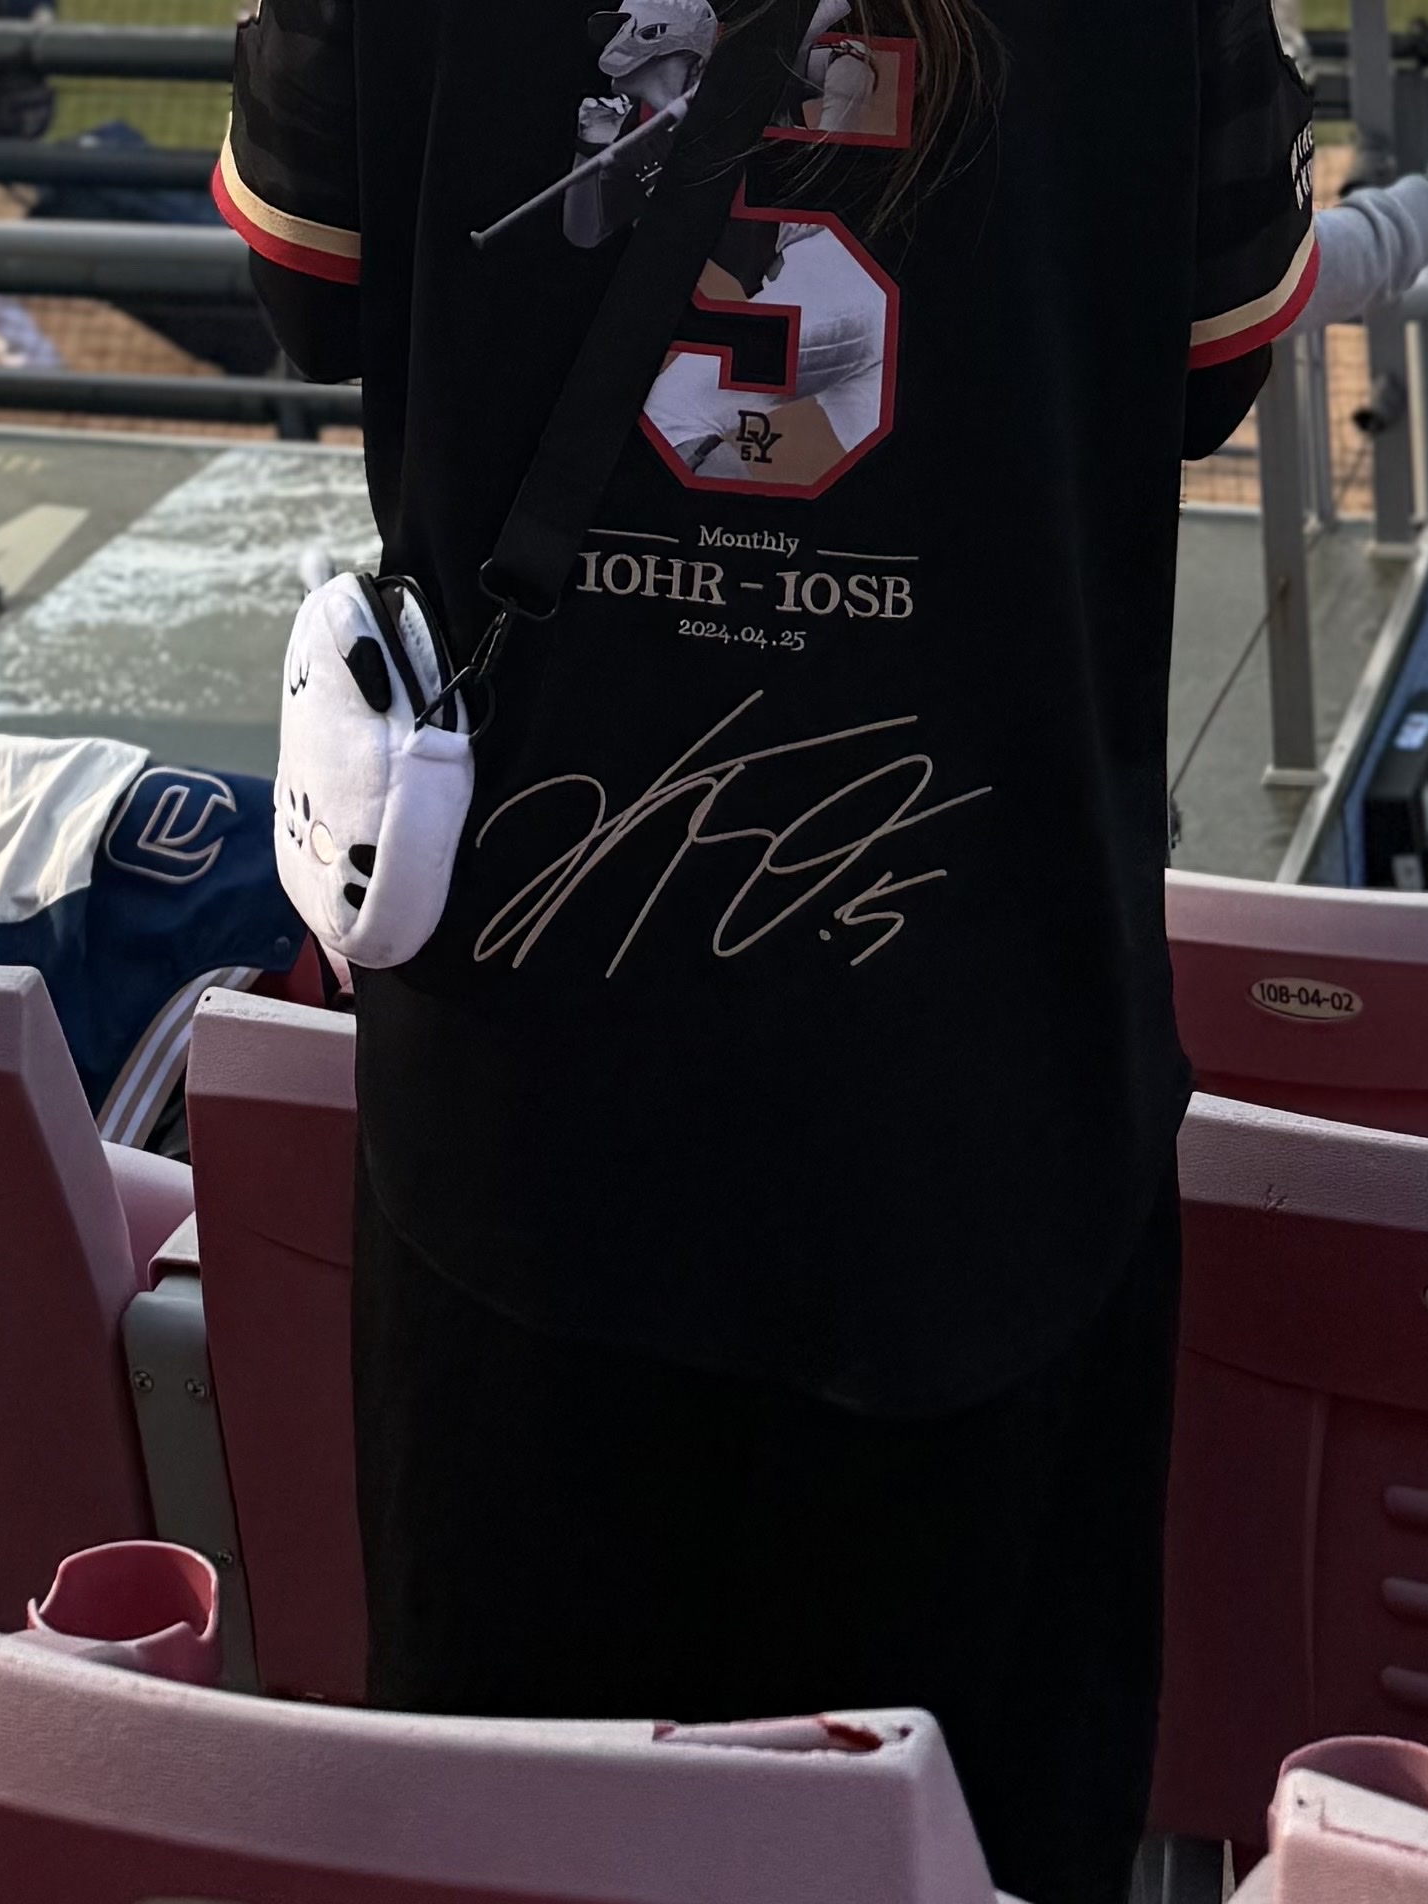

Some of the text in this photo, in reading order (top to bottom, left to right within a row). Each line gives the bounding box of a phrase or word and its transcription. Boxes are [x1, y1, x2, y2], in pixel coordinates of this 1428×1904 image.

[698, 525, 800, 558] Monthly
[678, 619, 807, 651] 2024.04.25
[1260, 982, 1355, 1012] 108-04-02
